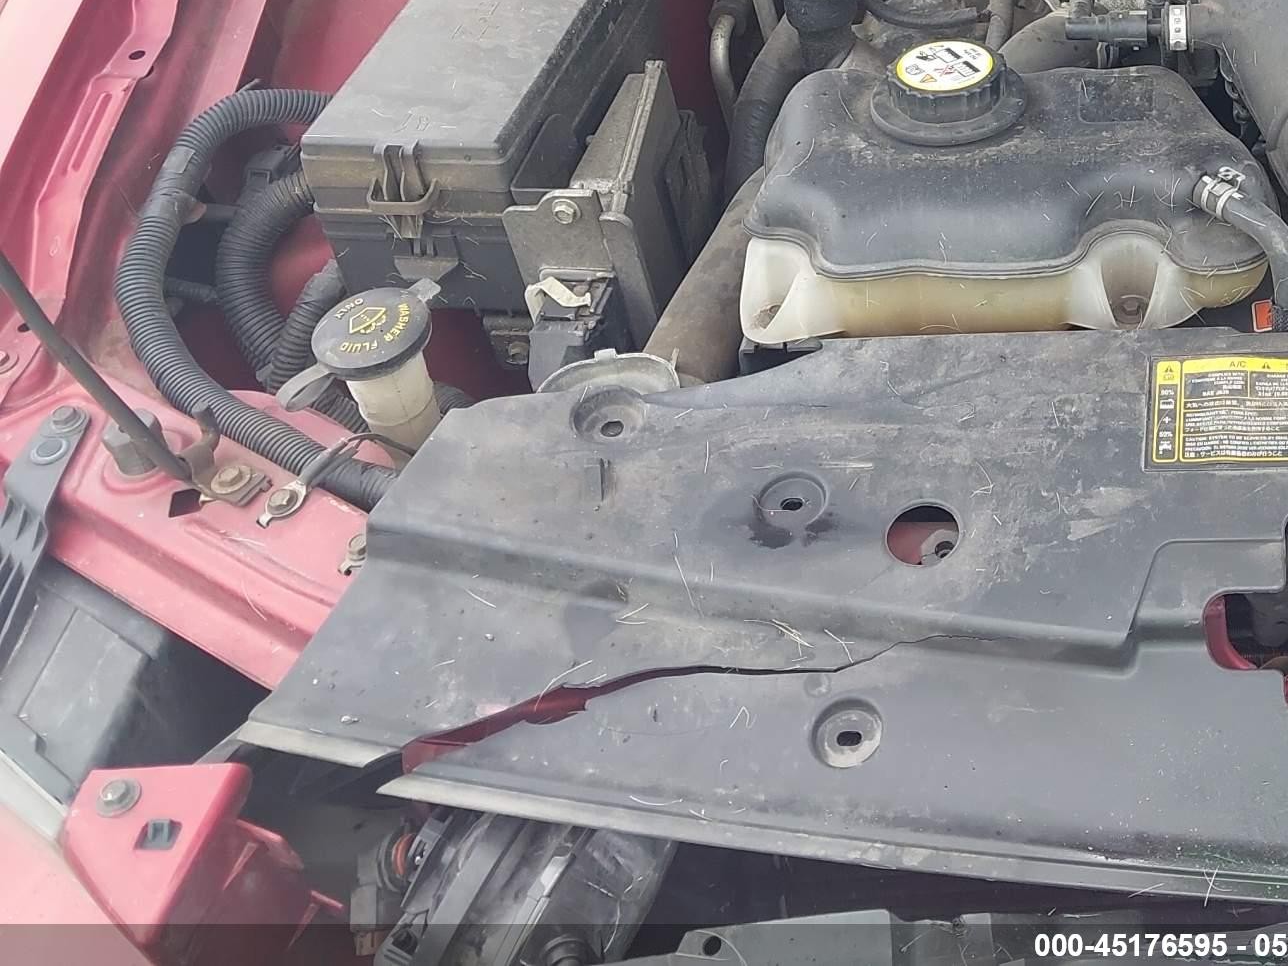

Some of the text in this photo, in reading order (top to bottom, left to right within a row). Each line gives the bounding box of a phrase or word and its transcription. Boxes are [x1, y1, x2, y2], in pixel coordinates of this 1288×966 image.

[333, 298, 364, 319] ONLY
[339, 302, 411, 354] WASHER FLUID
